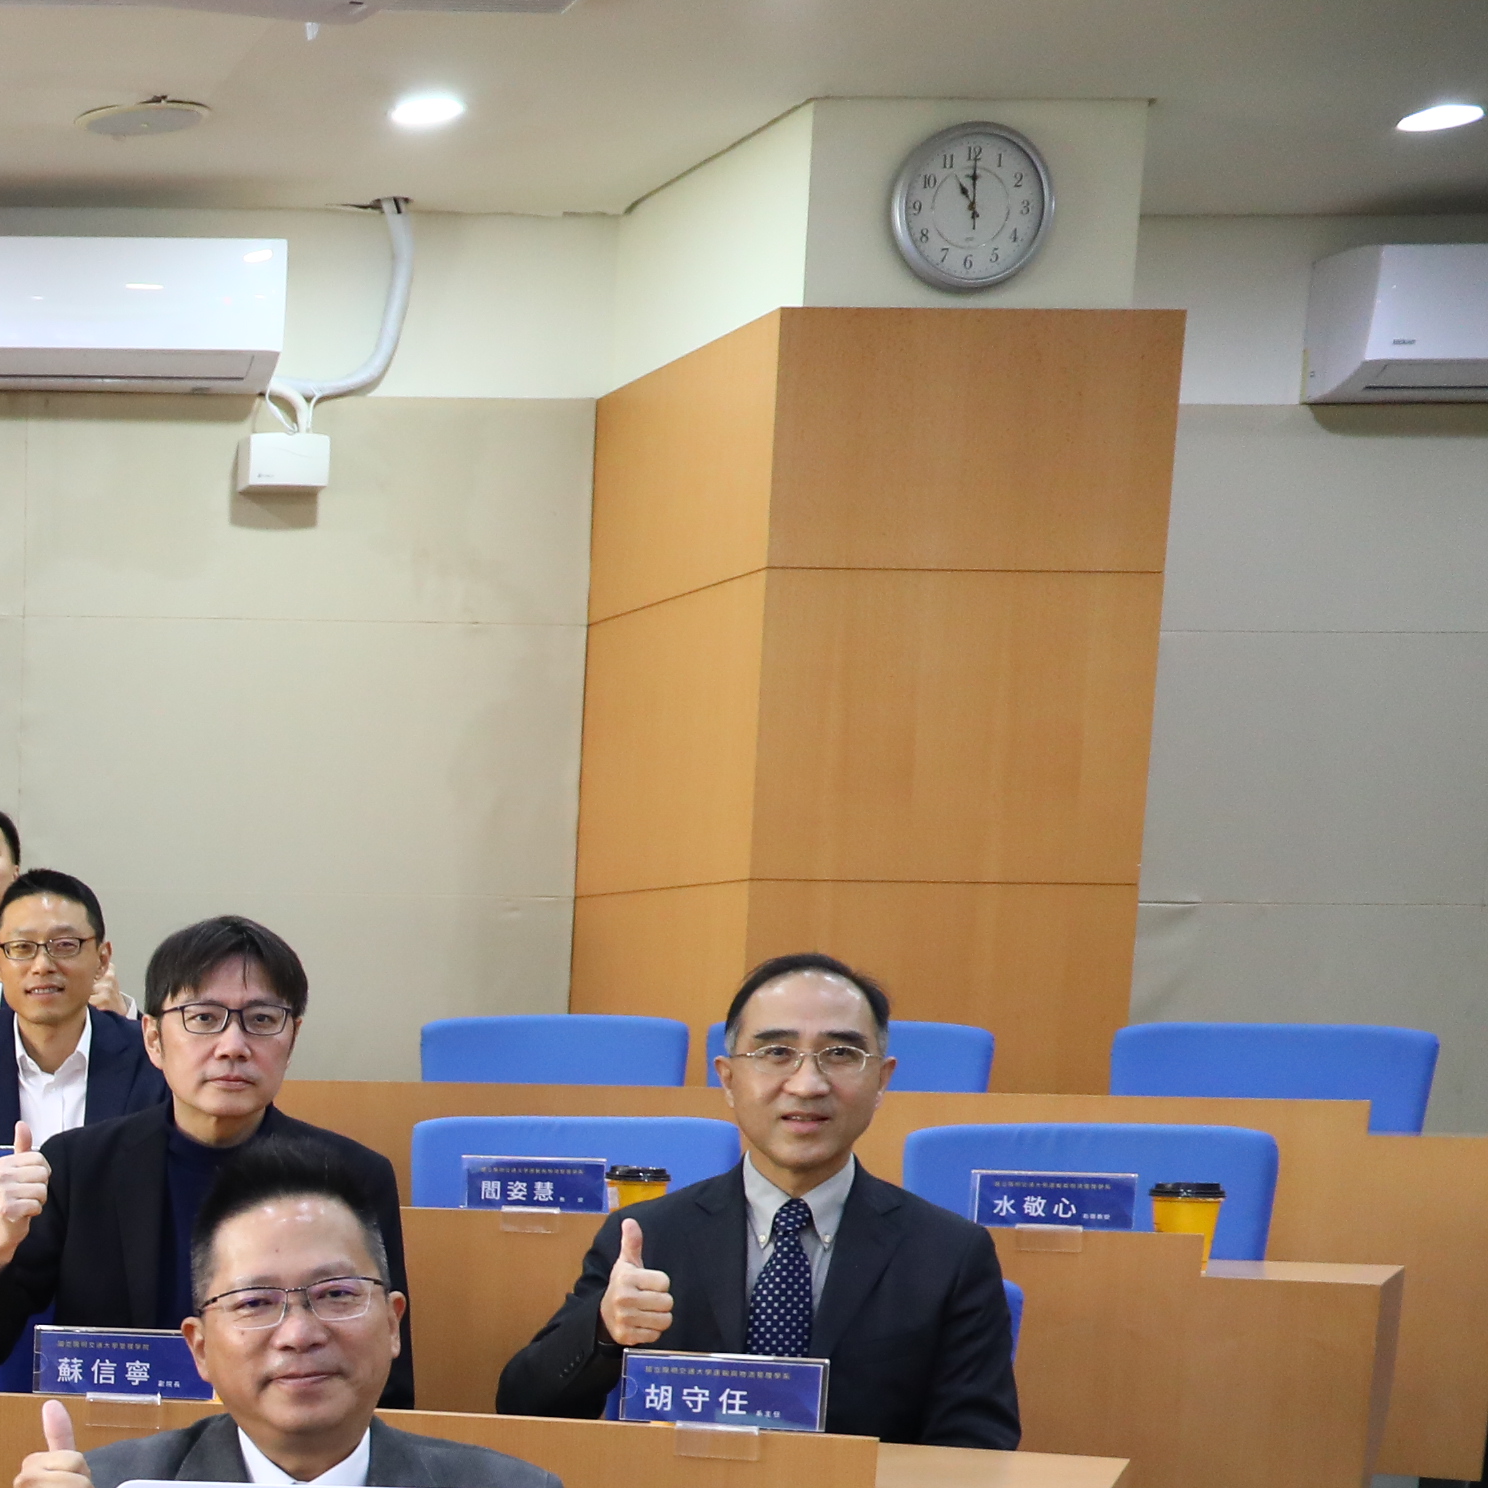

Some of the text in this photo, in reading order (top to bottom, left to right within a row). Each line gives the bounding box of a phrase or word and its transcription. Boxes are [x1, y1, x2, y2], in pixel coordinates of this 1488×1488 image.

[966, 145, 982, 161] 12
[996, 153, 1003, 168] 1
[942, 154, 955, 169] 11
[923, 174, 937, 188] 10
[1013, 172, 1023, 188] 2
[912, 200, 922, 215] 9
[1020, 200, 1030, 215] 3
[920, 228, 929, 243] 8
[1010, 228, 1018, 243] 4
[940, 248, 949, 263] 7
[963, 254, 973, 269] 6
[990, 248, 999, 263] 5
[993, 1195, 1077, 1218] 水敬心
[57, 1357, 151, 1386] 蘇信寧
[644, 1384, 748, 1415] 胡守任
